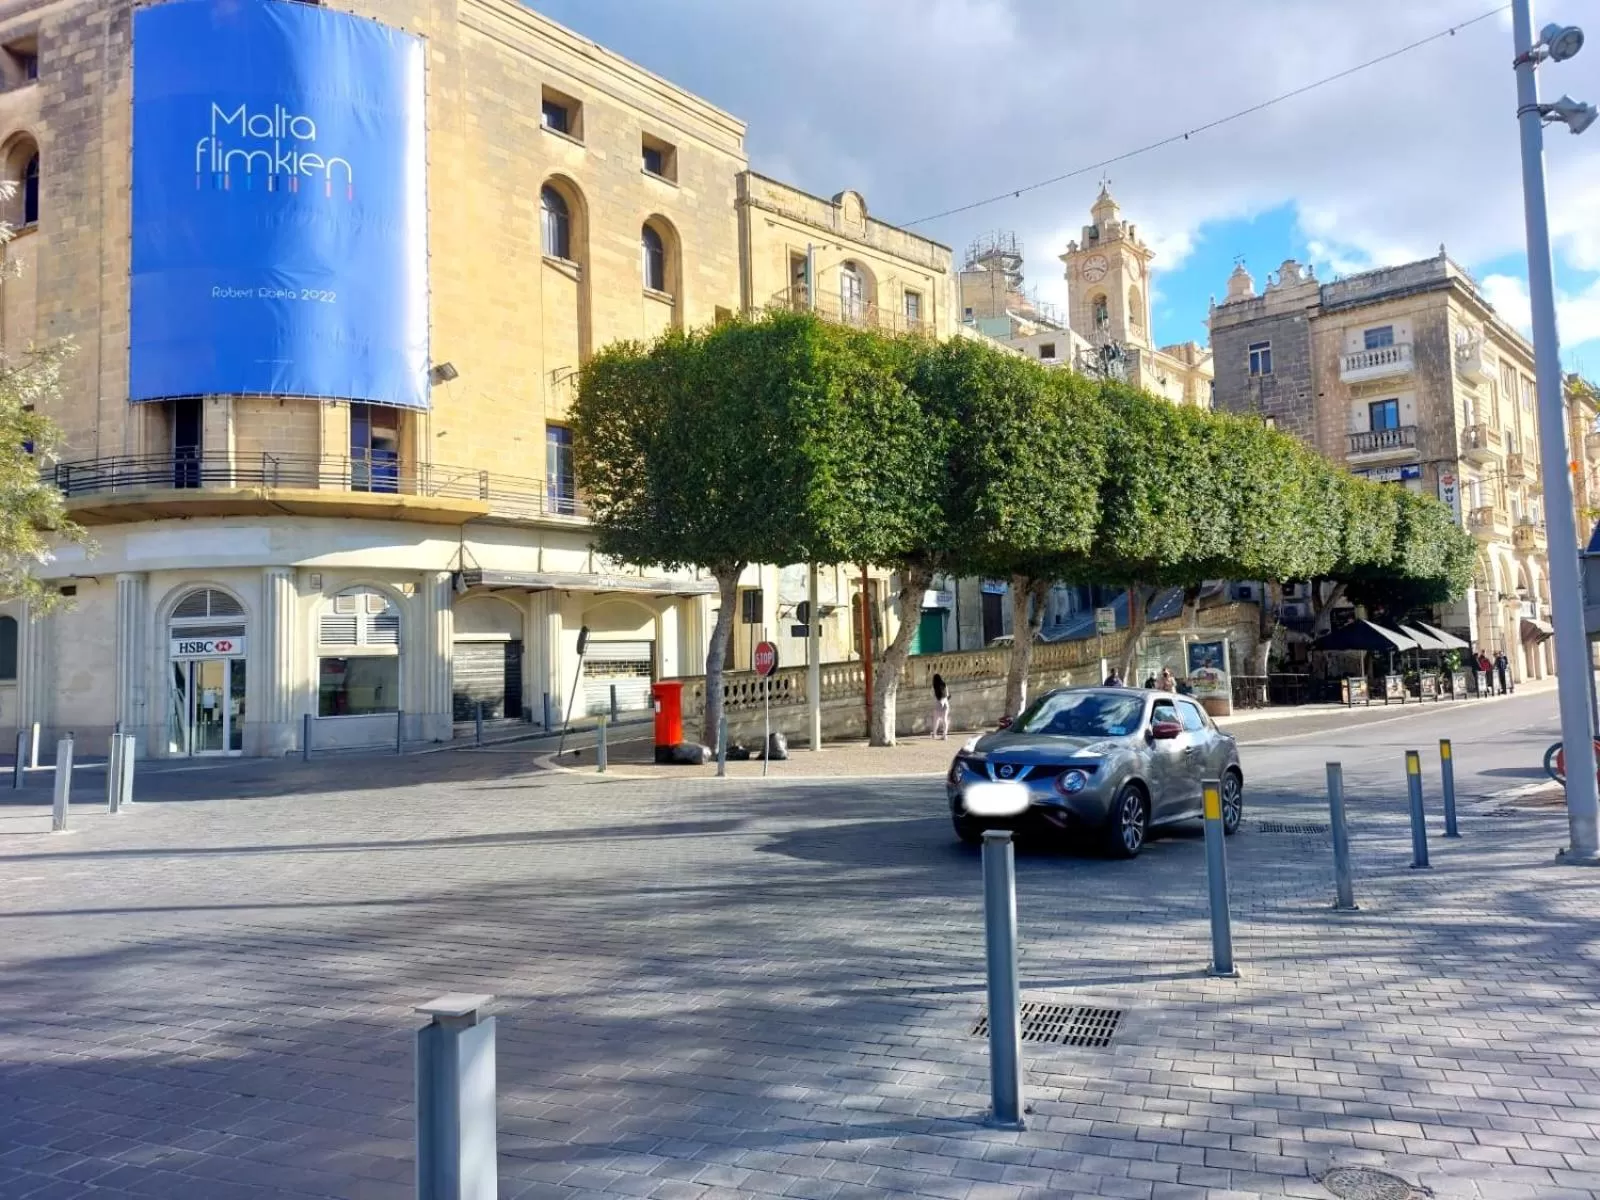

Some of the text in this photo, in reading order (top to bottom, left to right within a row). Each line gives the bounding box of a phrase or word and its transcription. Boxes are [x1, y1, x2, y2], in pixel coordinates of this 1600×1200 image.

[211, 101, 317, 141] Malta
[195, 136, 353, 194] flimkien
[212, 286, 253, 298] Robert
[301, 288, 337, 303] 2022
[179, 641, 214, 654] HSBC
[756, 651, 773, 666] STOP
